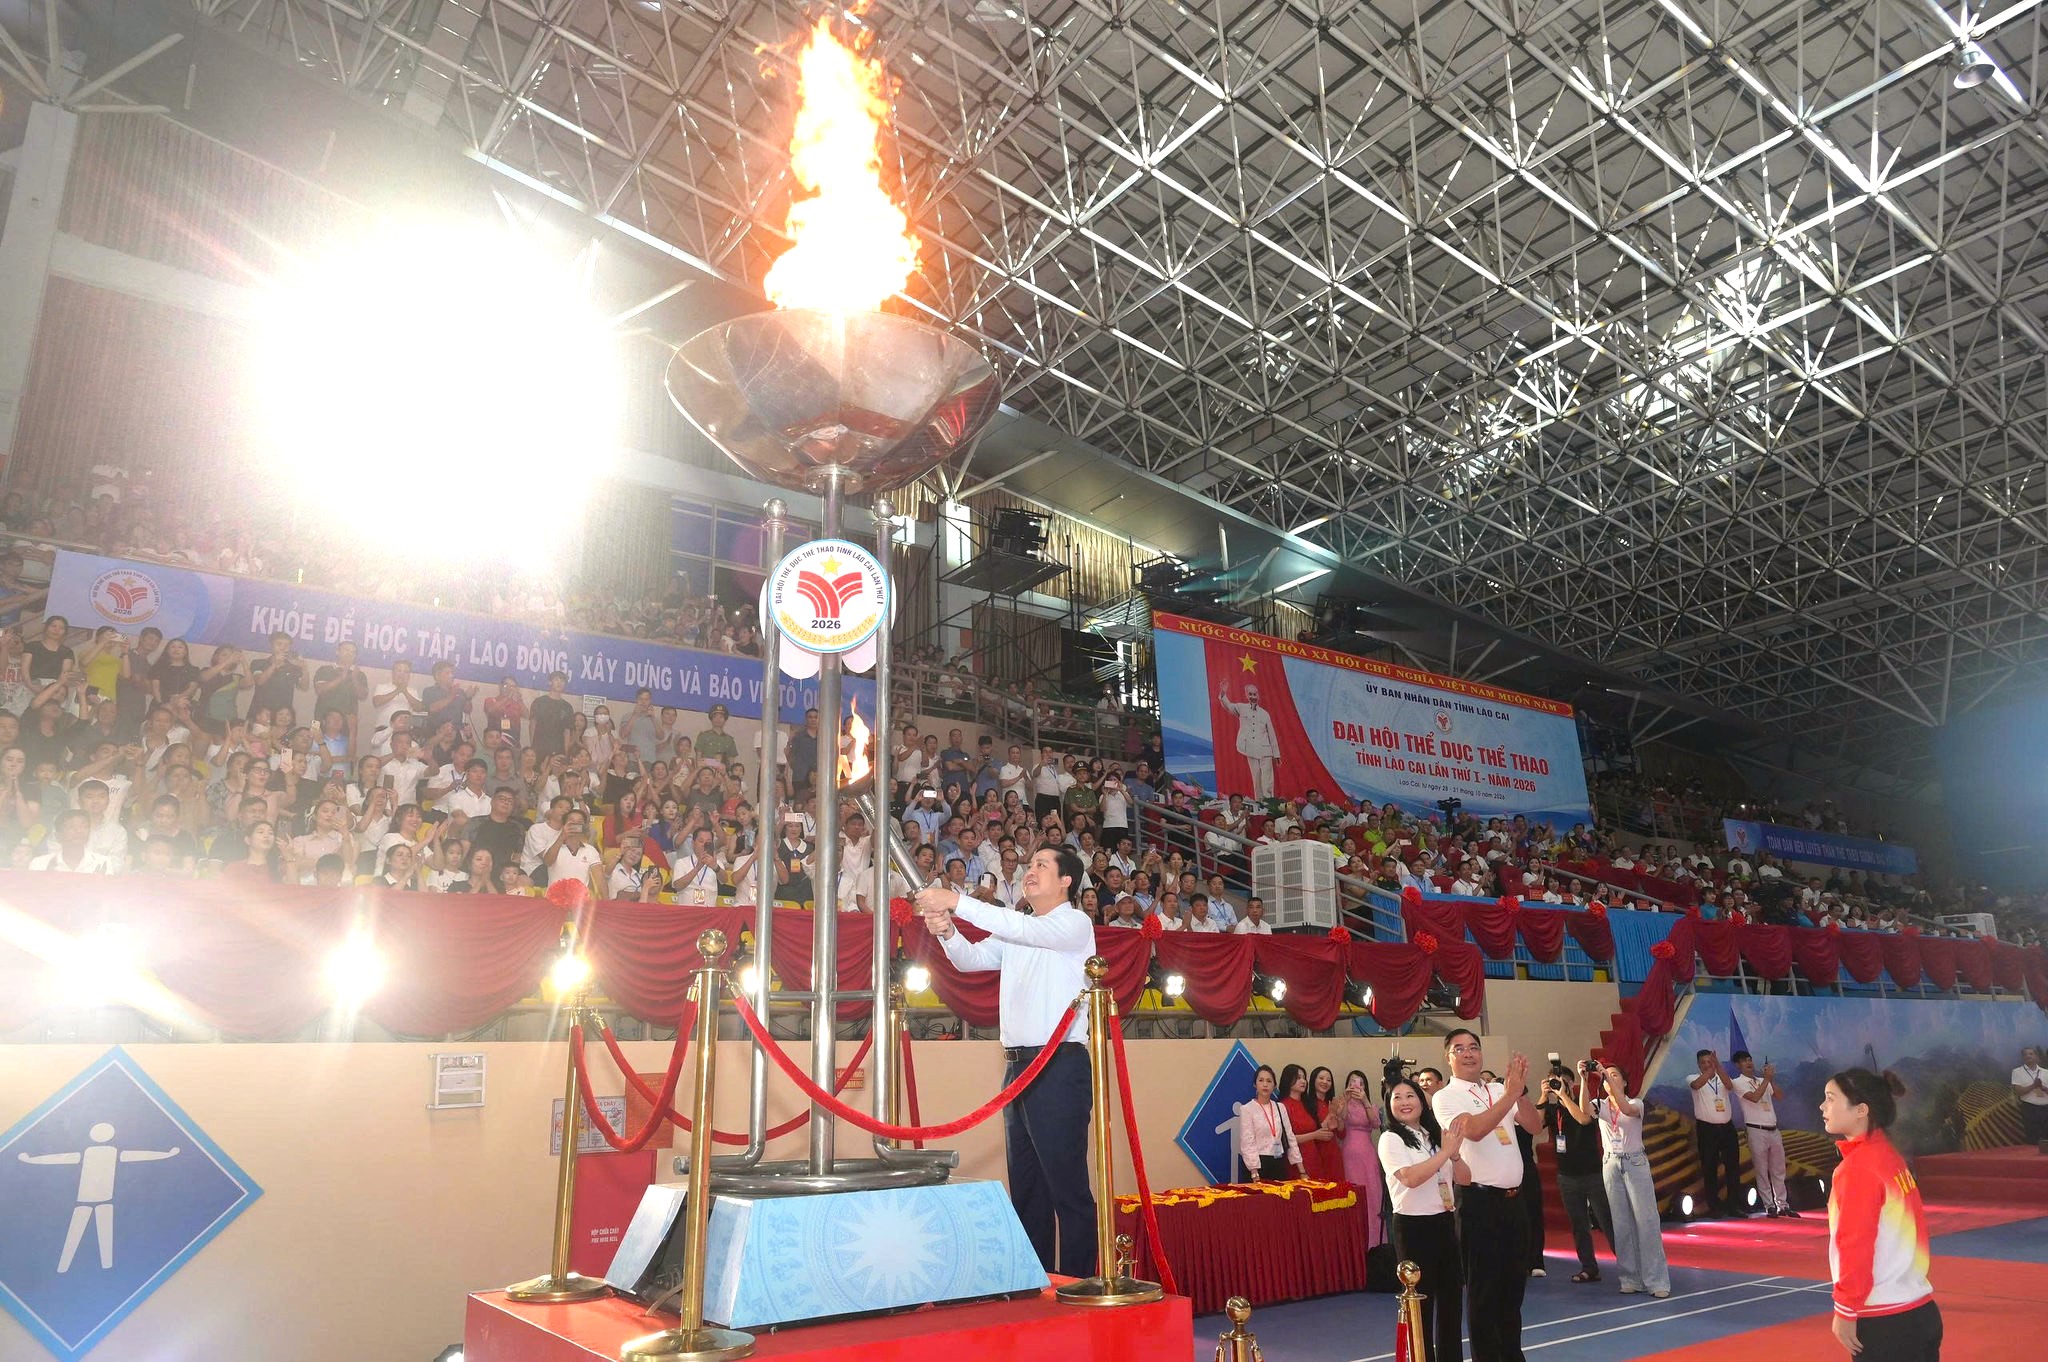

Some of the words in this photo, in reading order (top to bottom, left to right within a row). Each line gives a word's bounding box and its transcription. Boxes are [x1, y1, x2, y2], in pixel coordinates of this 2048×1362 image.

[811, 619, 841, 630] 2026
[251, 601, 316, 641] KHỎE
[324, 608, 356, 644] ĐỂ
[363, 622, 408, 660] HỌC
[469, 638, 508, 668] LAO
[516, 641, 573, 683] ĐỘNG,
[580, 651, 618, 684] XÂY
[680, 665, 701, 695] VÀ
[709, 667, 742, 701] BẢO
[1179, 620, 1225, 639] NƯỚC
[1229, 632, 1272, 649] CỘNG
[1276, 642, 1307, 658] HÒA
[1312, 649, 1330, 662] XÃ
[1335, 655, 1360, 669] HỘI
[1364, 661, 1391, 676] CHỦ
[1396, 669, 1435, 686] NGHĨA
[1439, 678, 1467, 692] VIỆT
[1470, 685, 1495, 699] NAM
[1498, 693, 1530, 707] MUÔN
[1534, 699, 1558, 712] NĂM
[1366, 681, 1378, 695] ỦY
[1381, 684, 1402, 699] BAN
[1404, 691, 1430, 706] NHÂN
[1432, 697, 1452, 710] DÂN
[1453, 700, 1475, 715] TỈNH
[1477, 705, 1493, 718] LÀO
[1495, 710, 1510, 722] CAI
[1333, 720, 1365, 746] ĐẠI
[1369, 726, 1400, 752] HỘI
[1404, 731, 1437, 756] THỂ
[1440, 740, 1474, 764] DỤC
[1477, 745, 1507, 769] THỂ
[1510, 753, 1549, 776] THAO
[1355, 748, 1382, 768] TỈNH
[1384, 755, 1405, 772] LÀO
[1408, 760, 1426, 775] CAI
[1487, 773, 1511, 788] NĂM
[1513, 778, 1536, 792] 2026
